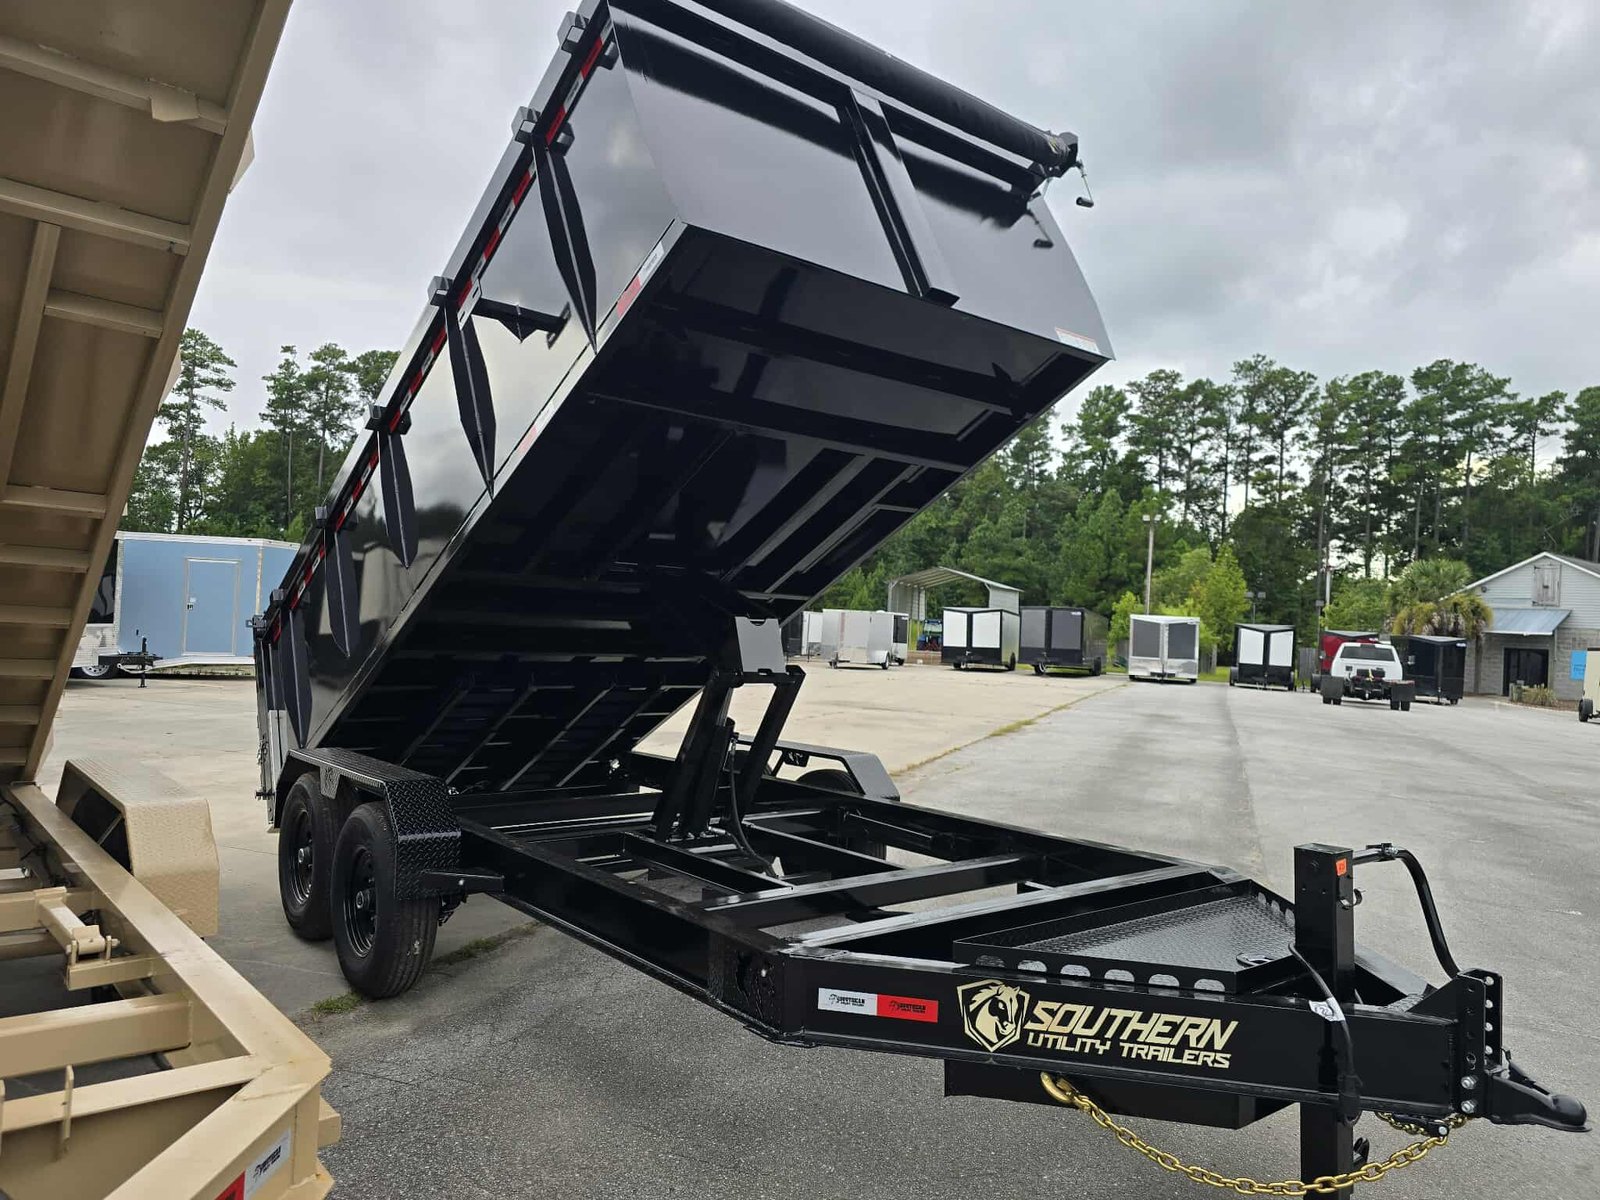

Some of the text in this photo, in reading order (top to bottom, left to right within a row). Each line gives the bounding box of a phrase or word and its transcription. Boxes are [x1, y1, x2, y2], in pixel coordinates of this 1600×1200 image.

[1023, 1000, 1239, 1050] SOUTHERN
[1026, 1032, 1232, 1069] UTILITY TRAILERS
